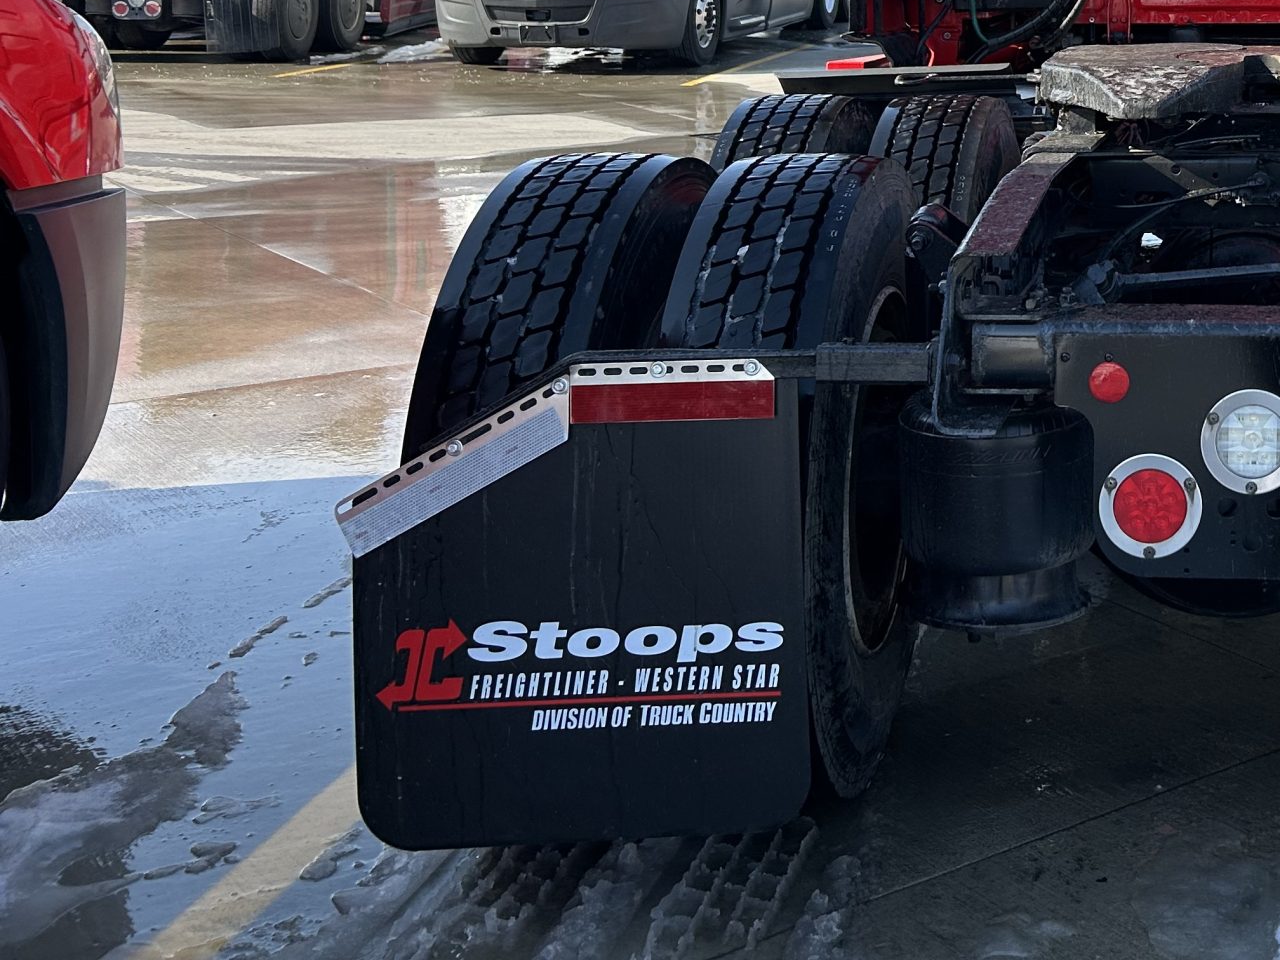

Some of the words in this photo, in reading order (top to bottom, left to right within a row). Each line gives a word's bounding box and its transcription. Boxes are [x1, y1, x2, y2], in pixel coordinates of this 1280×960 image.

[467, 620, 785, 663] Stoops
[469, 669, 609, 700] FREIGHTLINER
[634, 664, 724, 693] WESTERN
[732, 663, 781, 690] STAR
[531, 706, 609, 731] DIVISION
[610, 705, 633, 728] OF
[640, 703, 696, 727] TRUCK
[698, 701, 778, 724] COUNTRY
